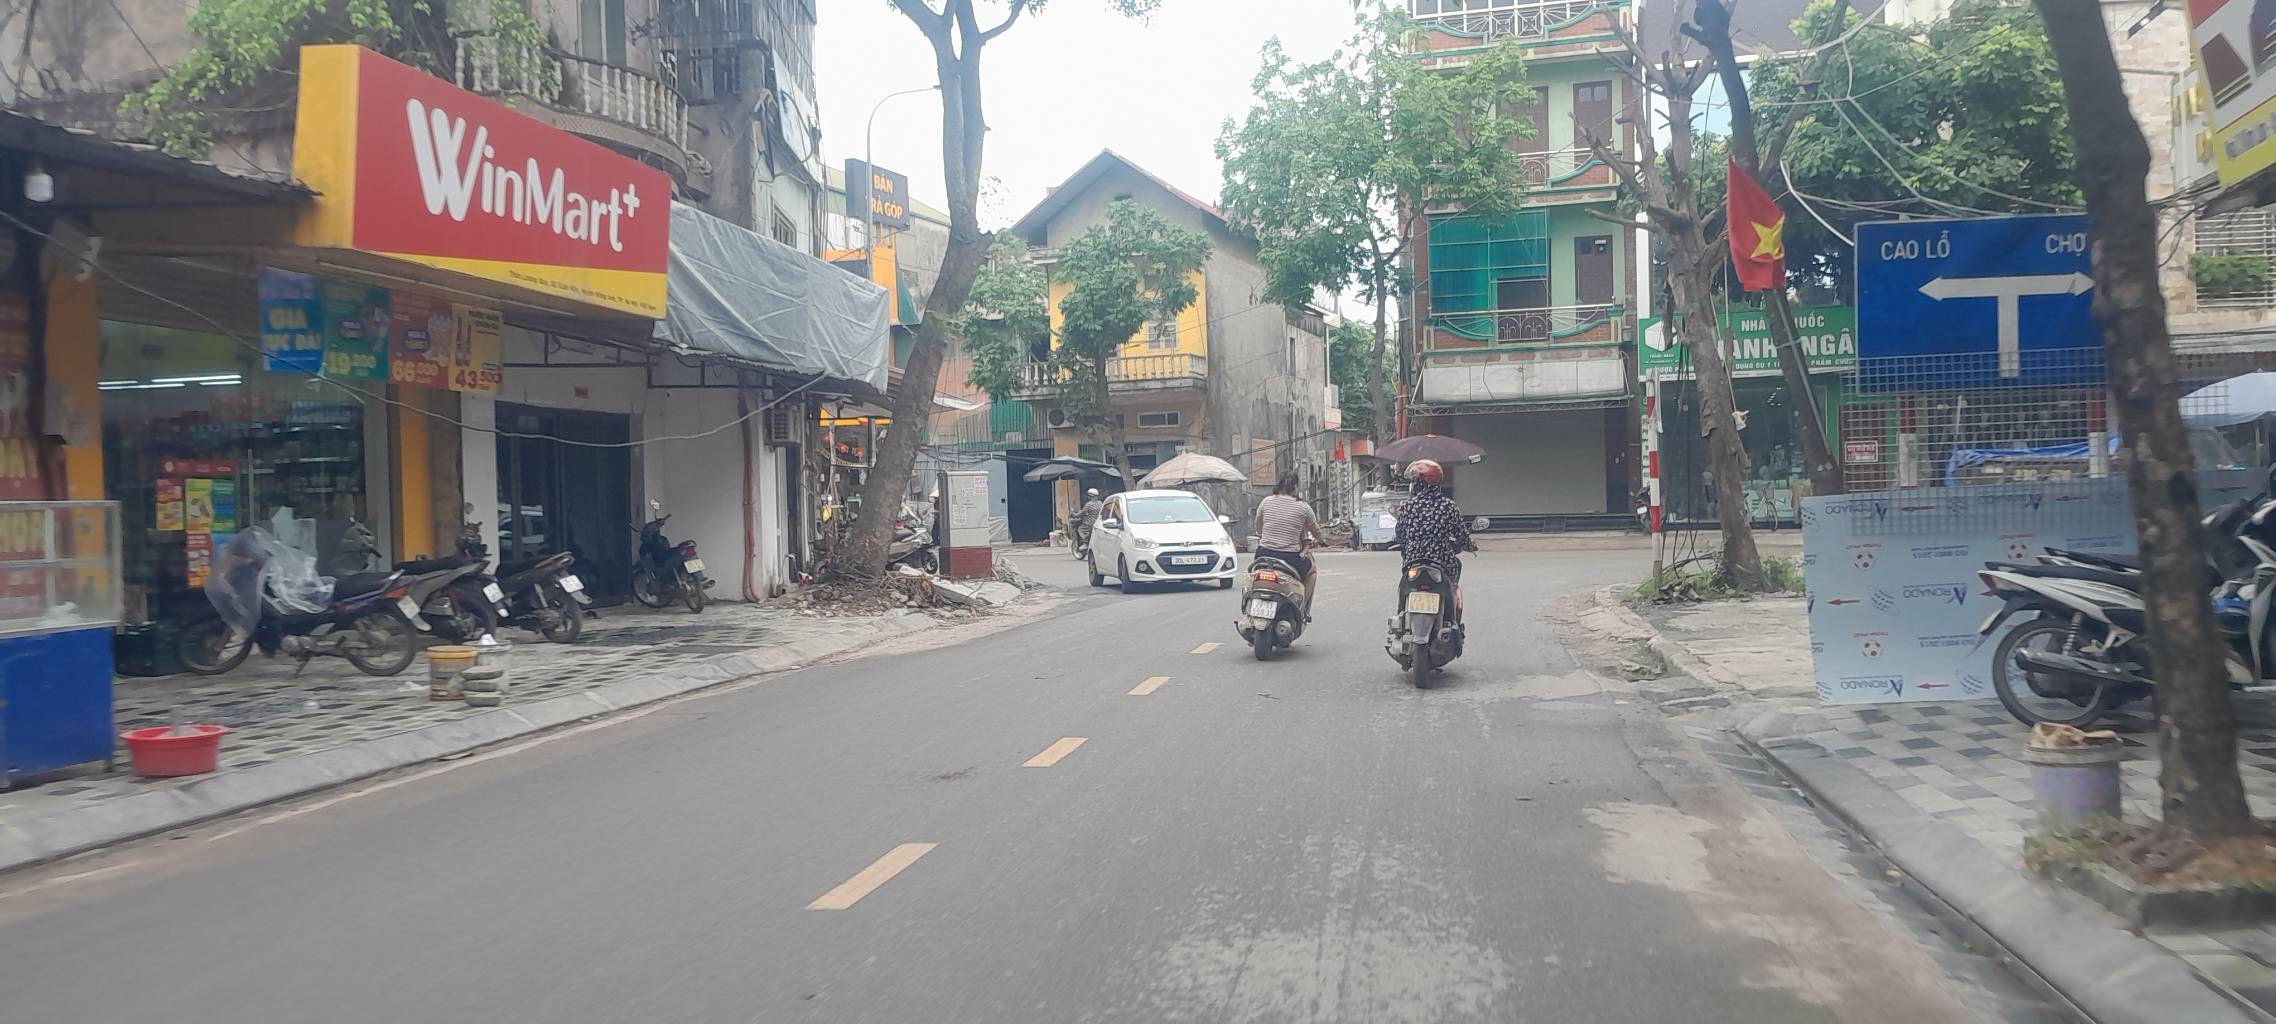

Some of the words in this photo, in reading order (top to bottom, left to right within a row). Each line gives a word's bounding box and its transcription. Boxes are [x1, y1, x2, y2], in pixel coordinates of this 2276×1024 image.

[406, 98, 641, 253] WinMart+
[873, 173, 893, 194] BÁN
[884, 200, 903, 219] GÓP
[1881, 239, 1920, 260] CAO
[1925, 230, 1950, 259] LỖ
[2045, 232, 2087, 257] CHỢ
[1741, 318, 1766, 332] NHÀ
